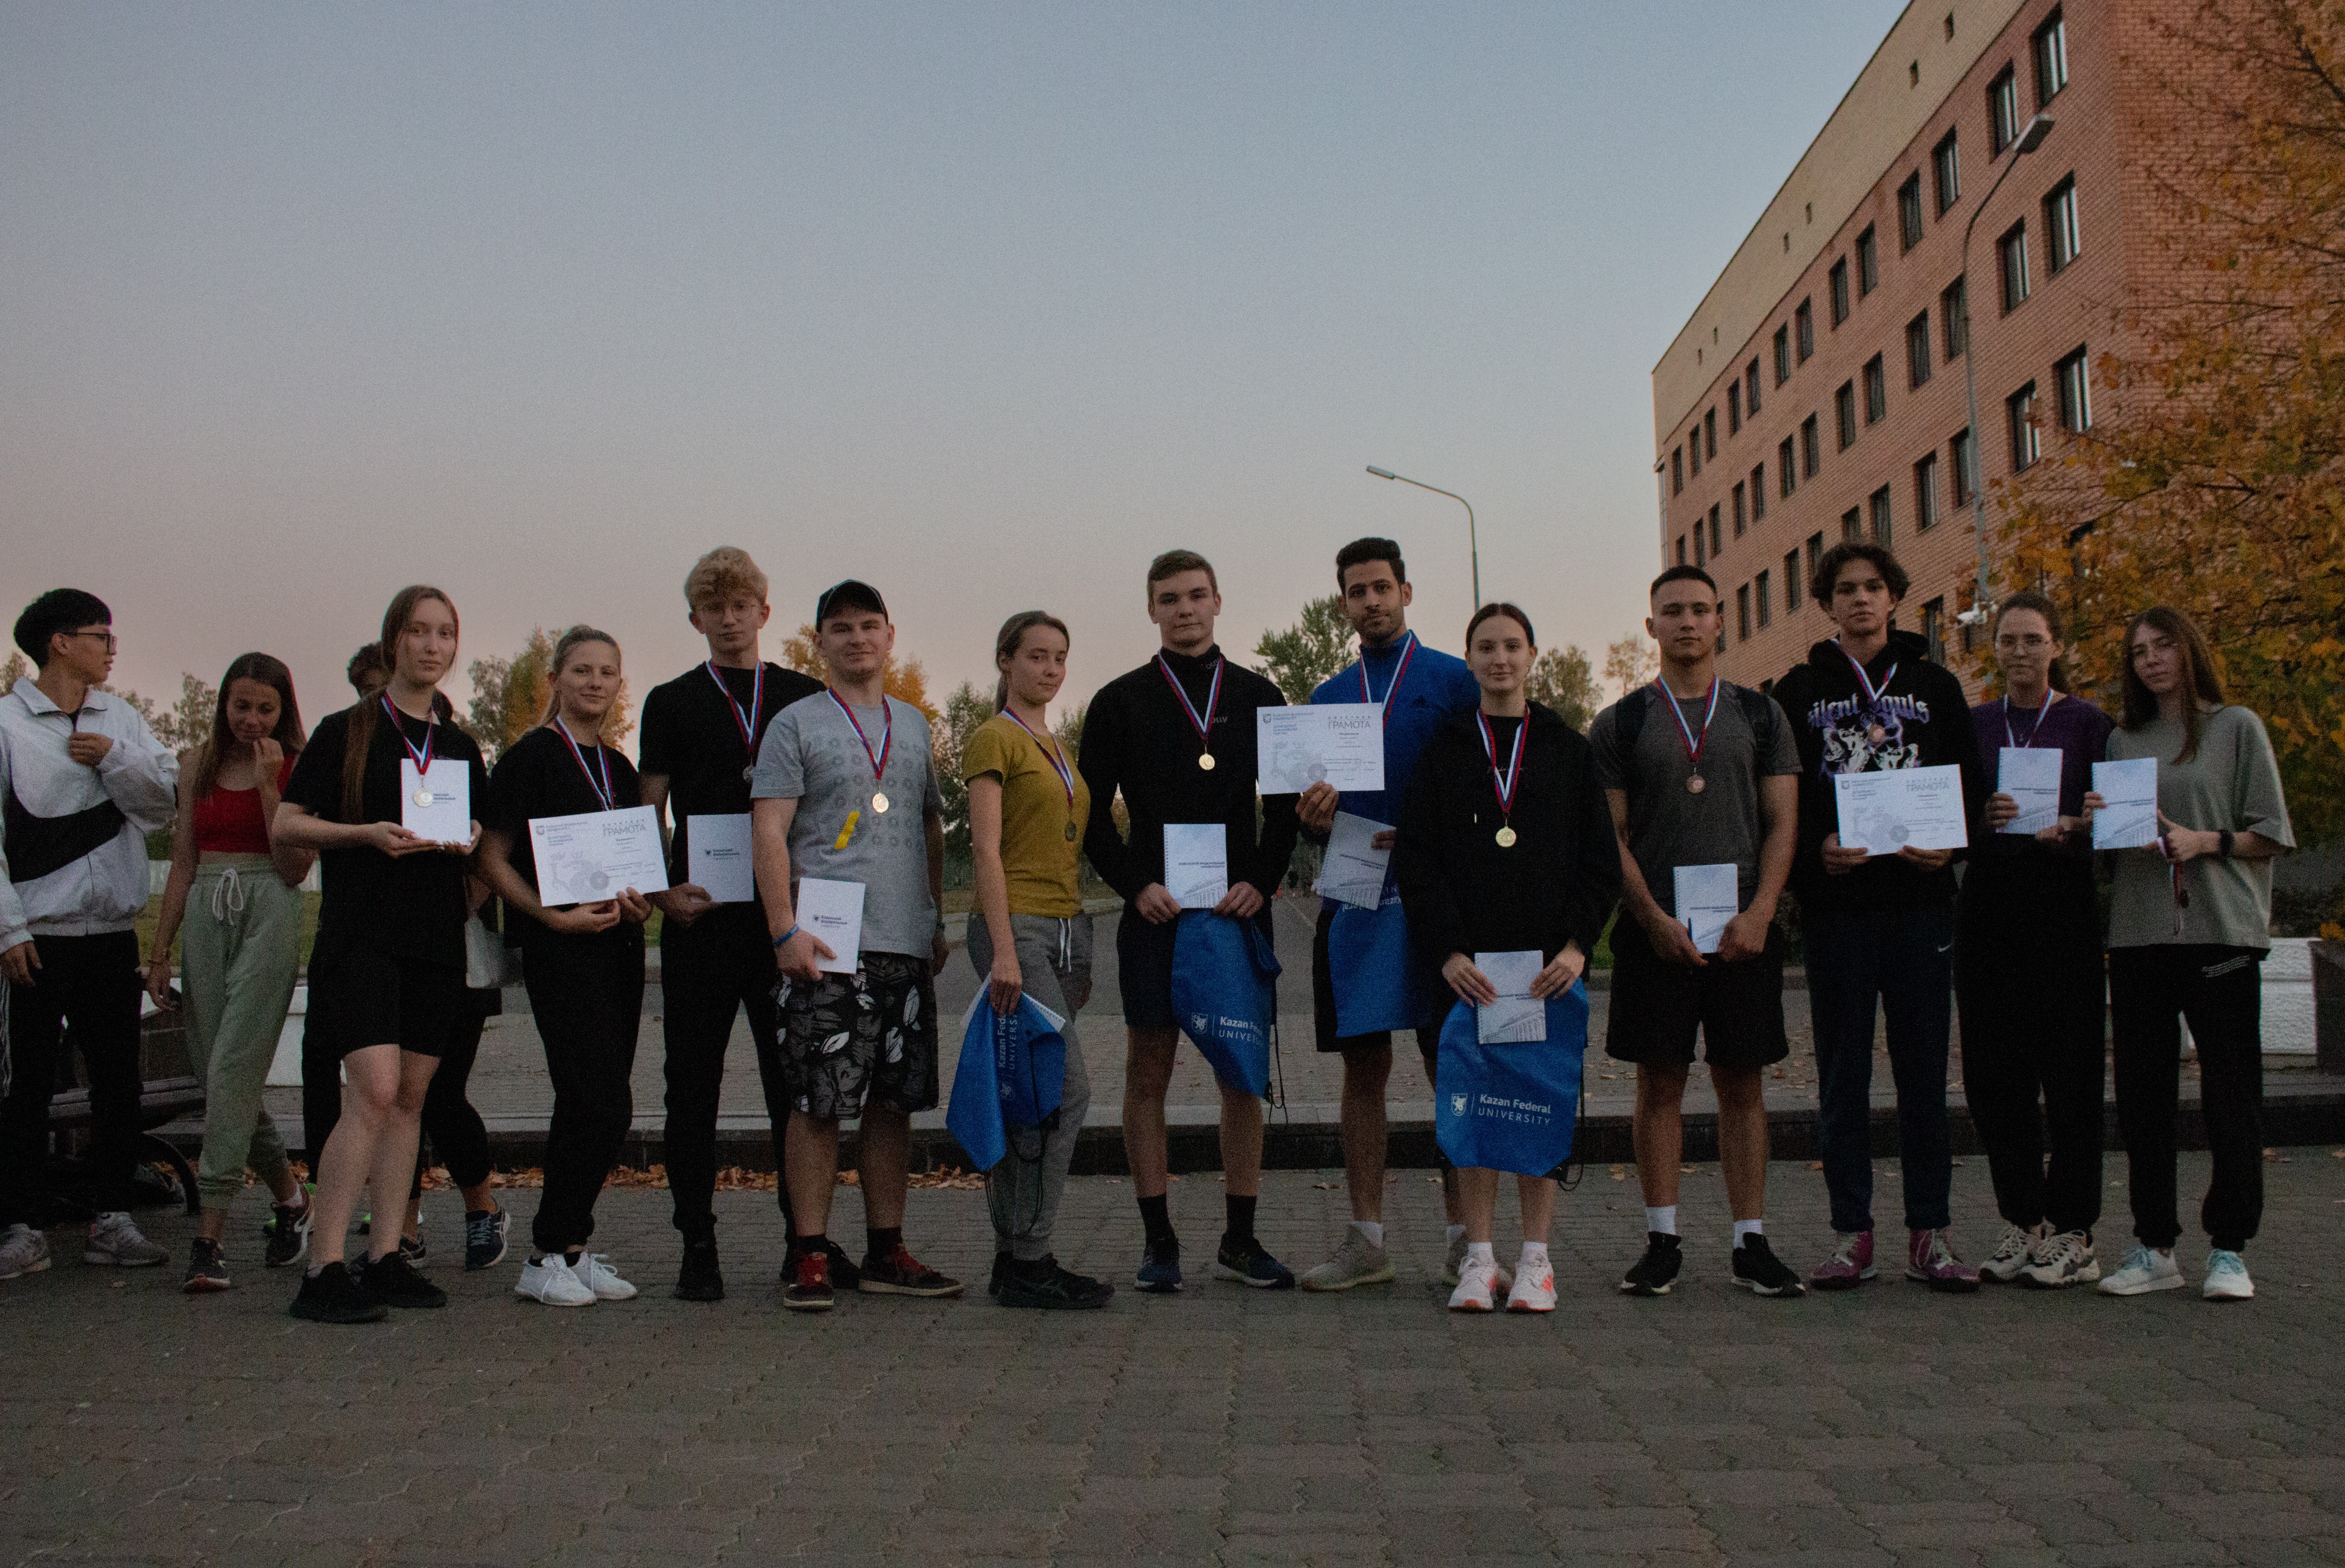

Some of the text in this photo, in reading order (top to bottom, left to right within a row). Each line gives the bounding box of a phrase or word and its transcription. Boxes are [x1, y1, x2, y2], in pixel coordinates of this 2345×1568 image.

[1328, 721, 1371, 729] ГРАМОТА
[603, 824, 646, 836] ГРАМОТА
[1220, 1016, 1248, 1030] Kazan
[997, 1014, 1006, 1068] Kazan Fed
[1480, 1094, 1551, 1114] Kazan Federal
[1478, 1107, 1551, 1126] UNIVERSITY
